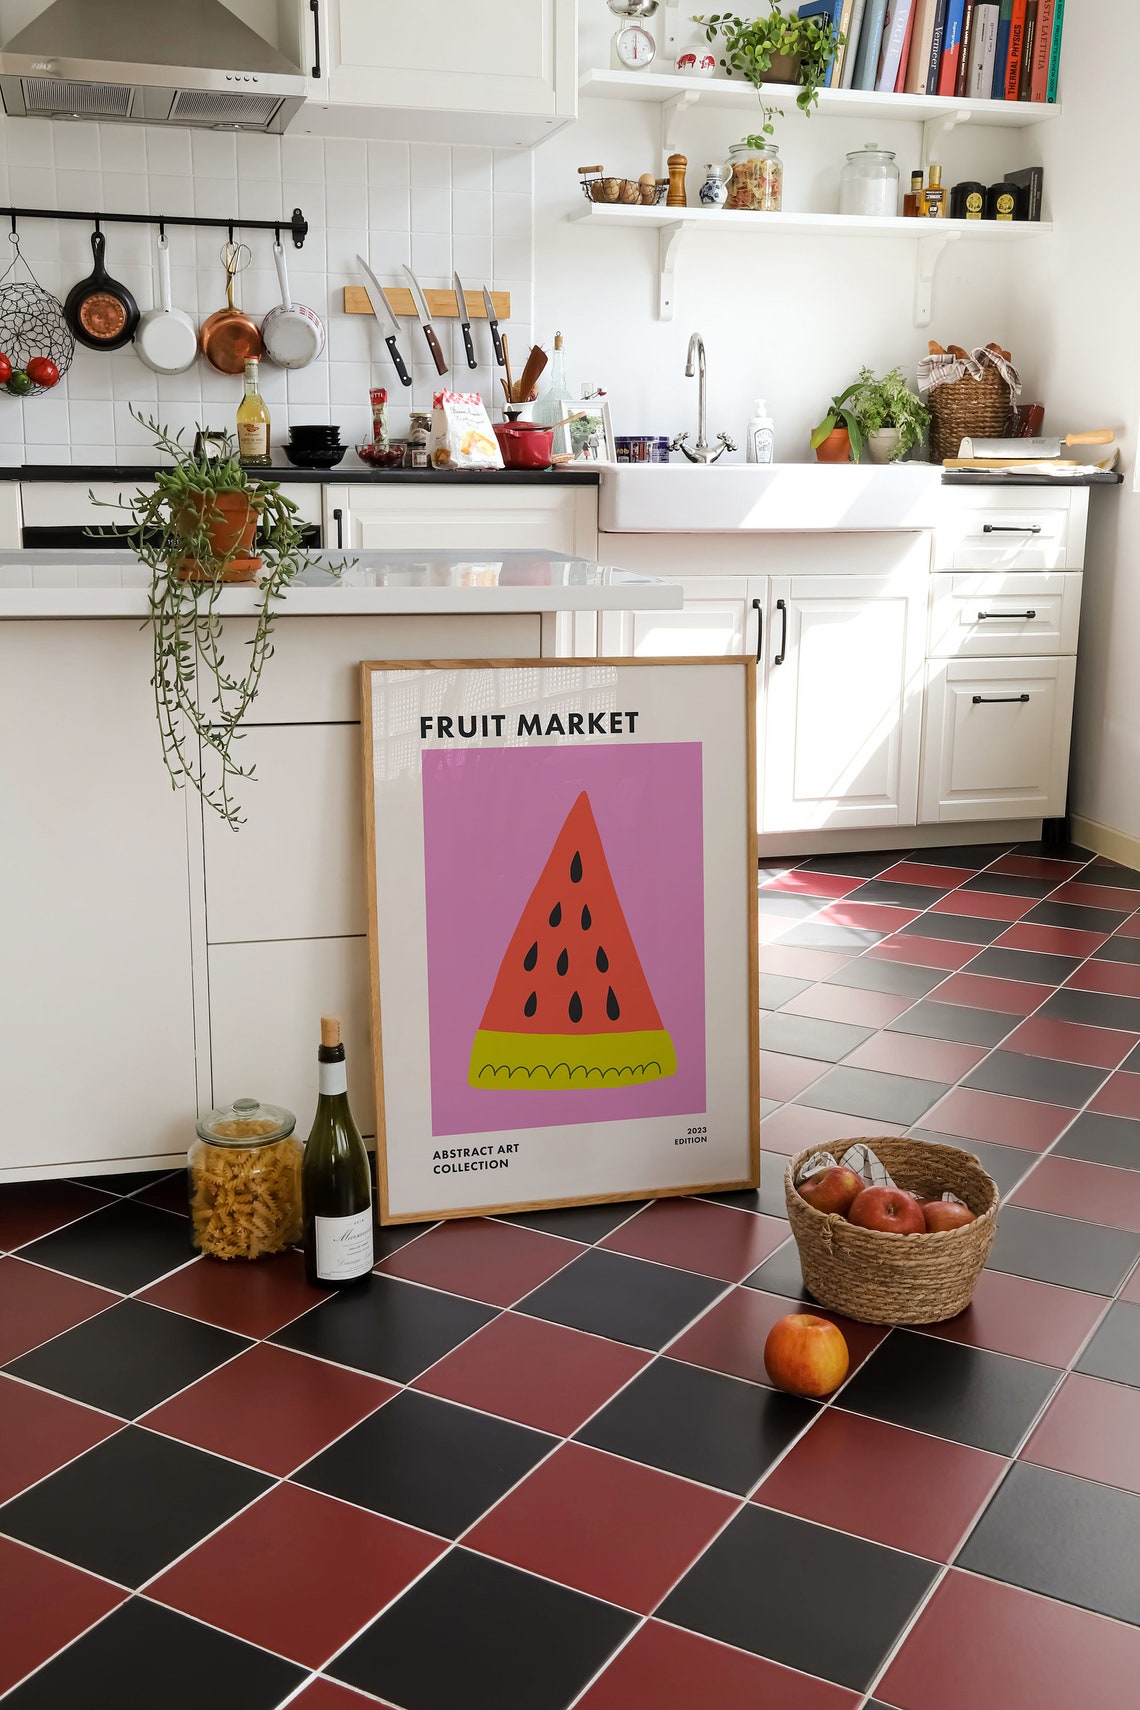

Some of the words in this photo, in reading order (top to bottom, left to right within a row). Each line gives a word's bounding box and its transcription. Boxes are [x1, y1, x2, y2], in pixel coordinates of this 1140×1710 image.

[889, 8, 908, 58] VOGUE
[930, 25, 944, 70] Vermeer
[1011, 24, 1022, 57] PHYSICS
[1037, 25, 1049, 70] LAETITIA
[1007, 59, 1019, 95] THERMAL
[420, 715, 506, 738] FRUIT
[517, 711, 639, 736] MARKET
[674, 1136, 708, 1145] EDITION
[687, 1126, 707, 1135] 2023
[432, 1145, 494, 1160] ABSTRACT
[497, 1143, 520, 1155] ART
[433, 1158, 509, 1174] COLLECTION
